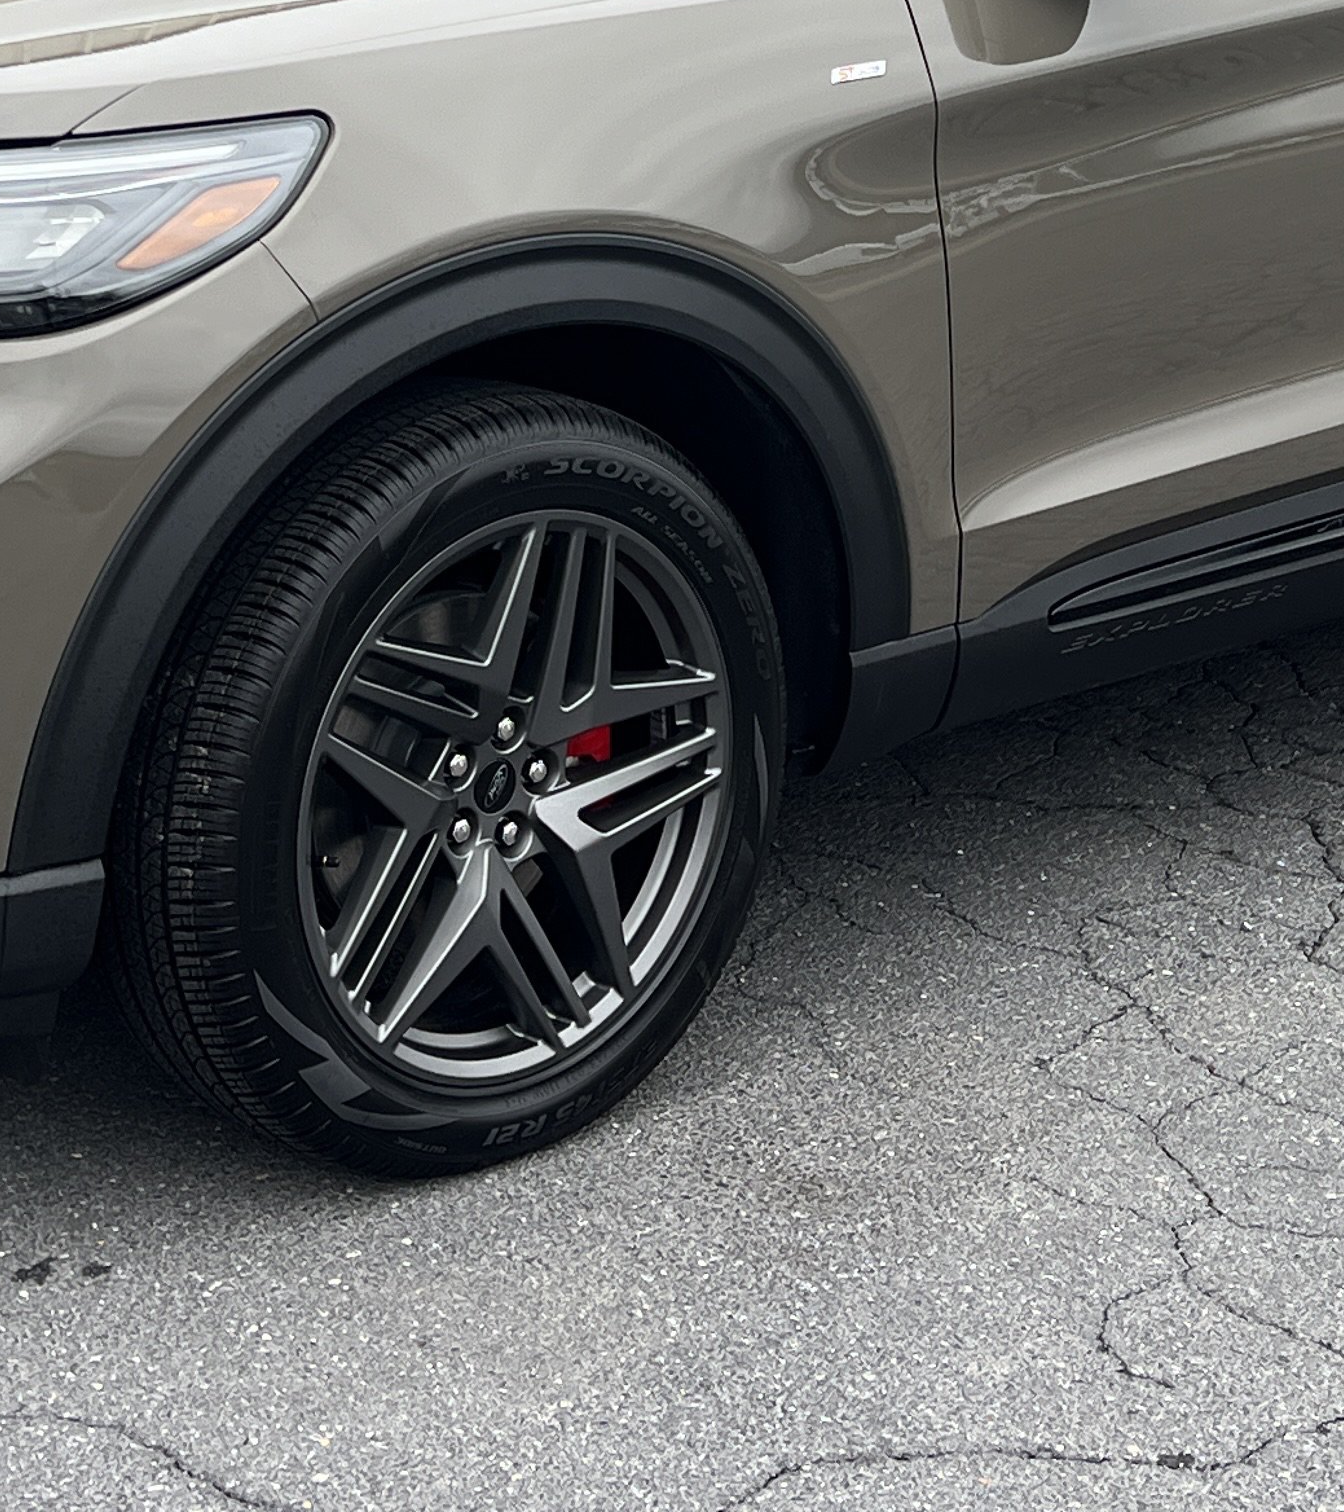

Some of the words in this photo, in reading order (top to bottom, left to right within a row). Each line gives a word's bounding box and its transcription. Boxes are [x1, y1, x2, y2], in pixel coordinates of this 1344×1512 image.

[543, 457, 724, 549] SCORPION
[722, 563, 772, 681] ZERO
[1060, 584, 1289, 654] EXPLORER
[482, 1113, 548, 1147] R21
